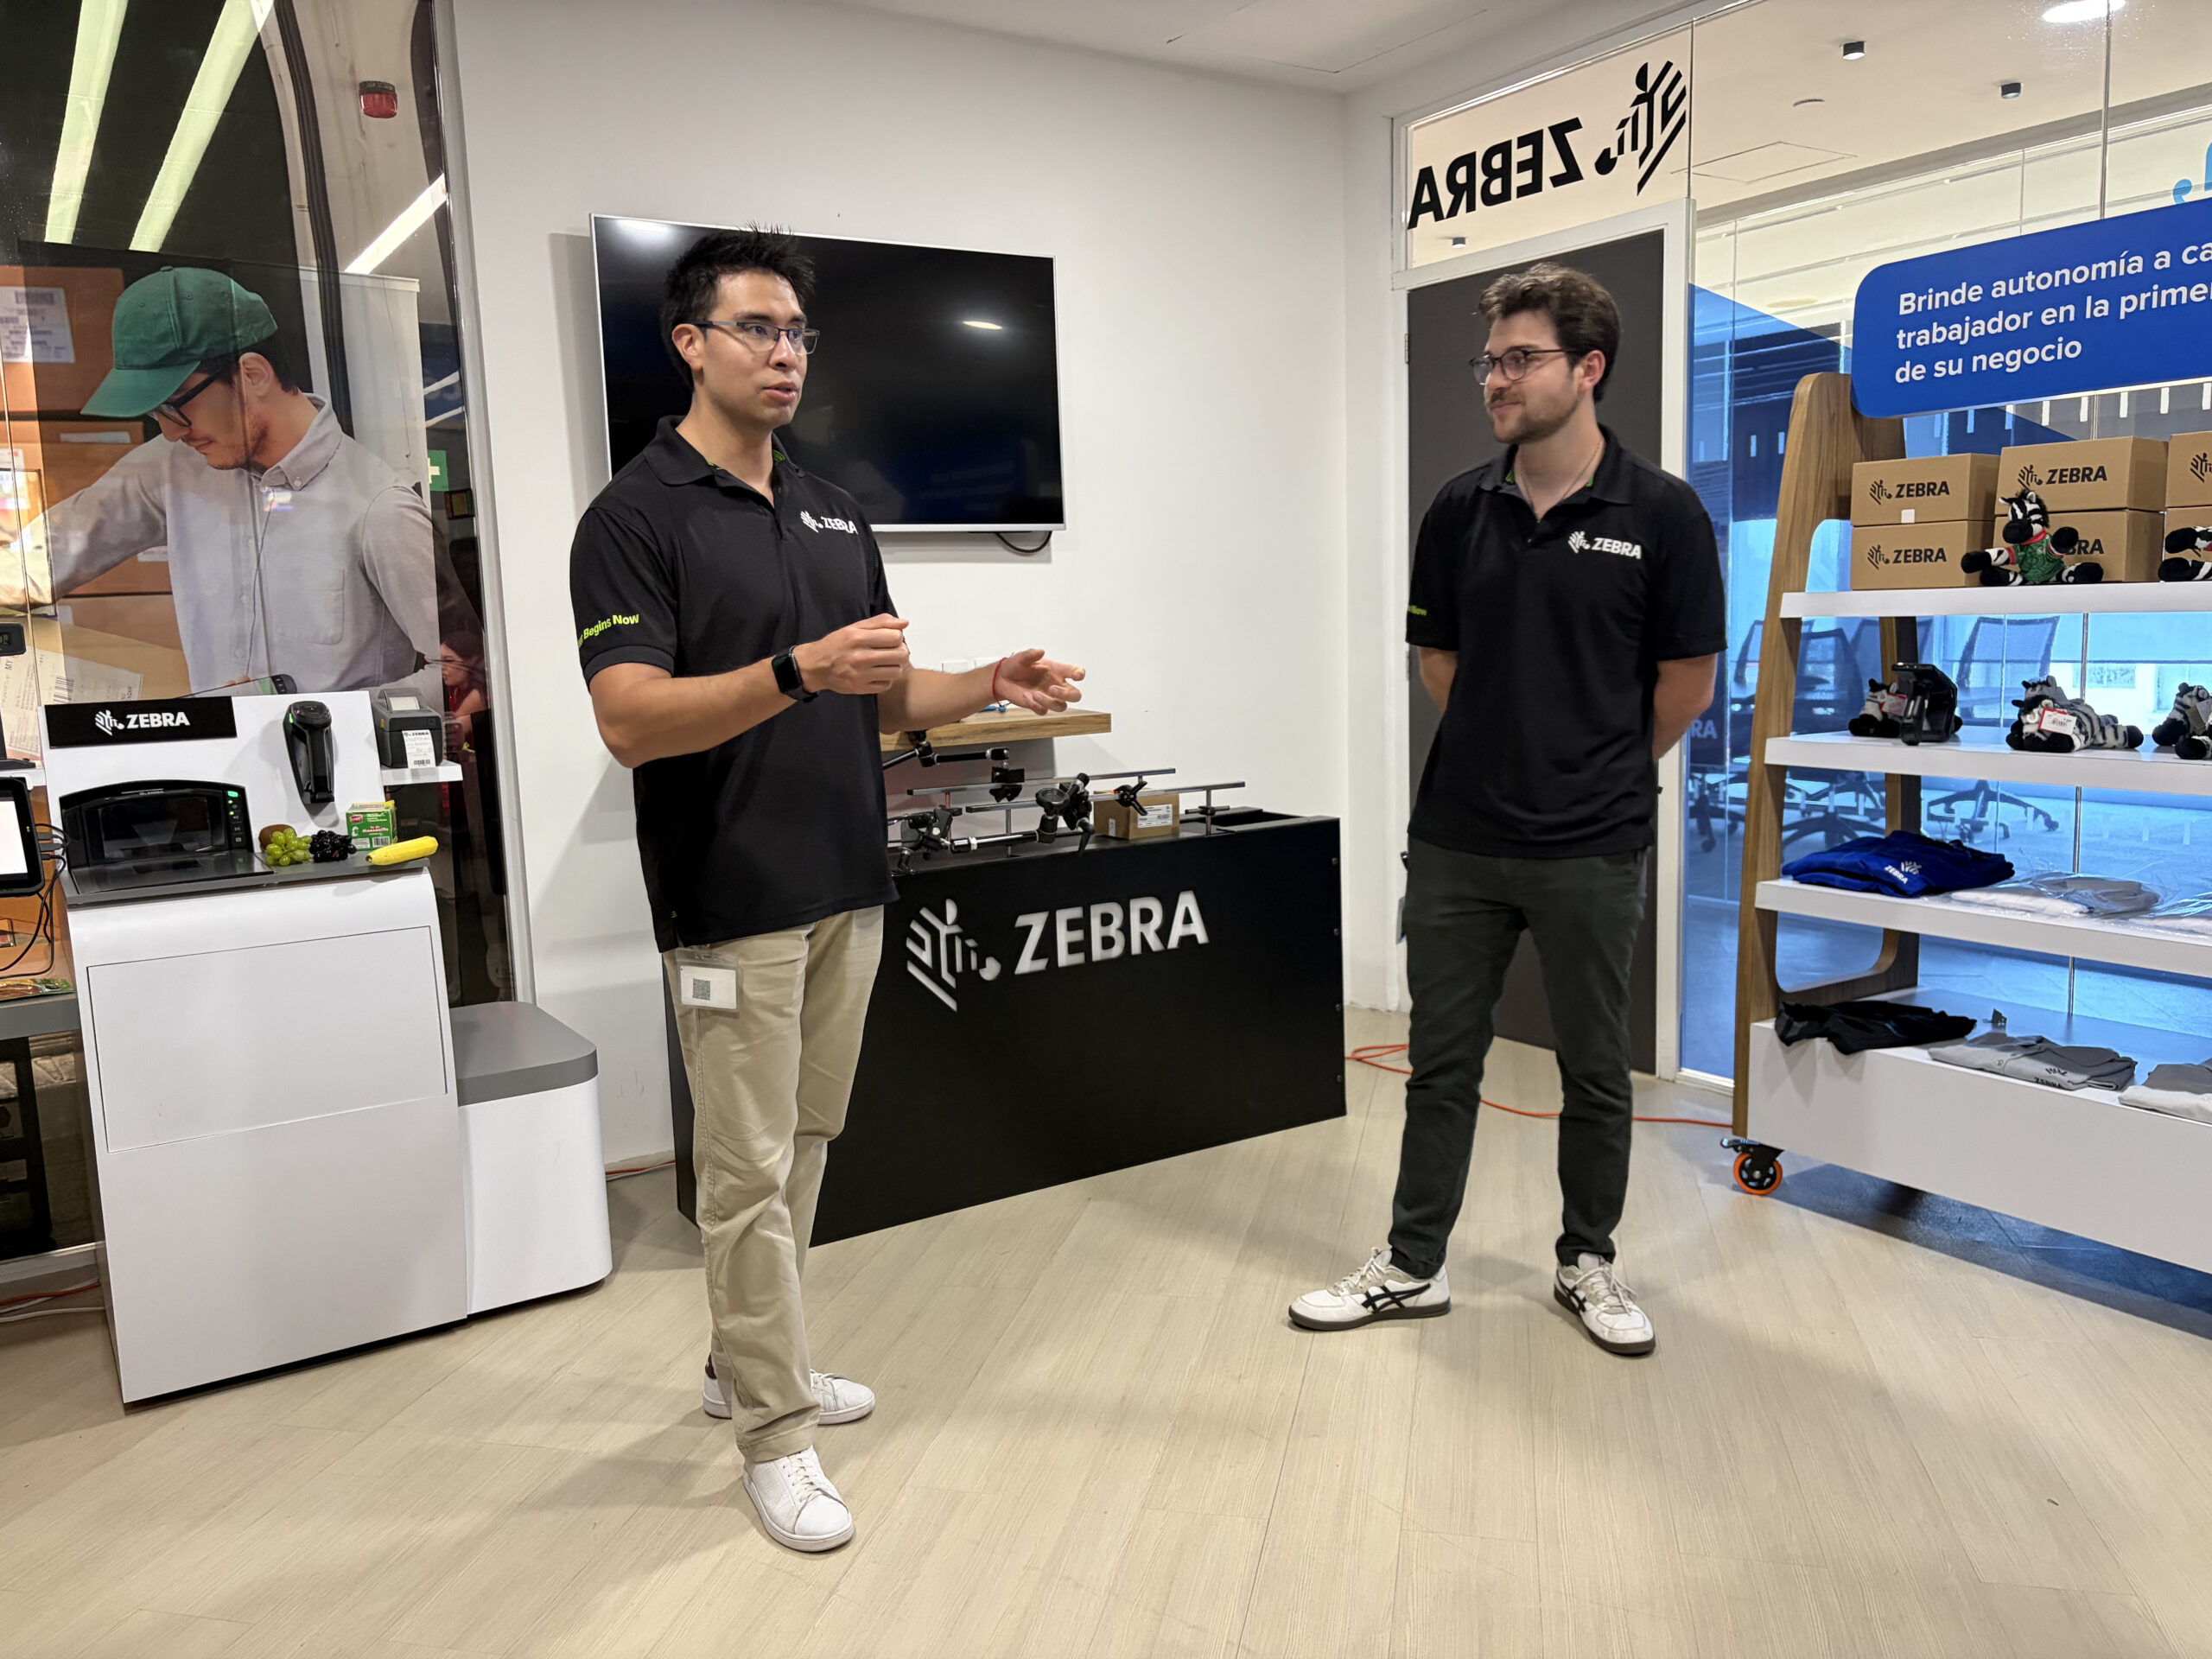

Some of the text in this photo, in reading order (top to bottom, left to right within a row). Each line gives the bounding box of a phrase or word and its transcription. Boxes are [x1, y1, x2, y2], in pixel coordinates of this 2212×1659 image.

[1899, 282, 1983, 315] Brinde
[1991, 250, 2144, 298] autonomía
[2153, 251, 2171, 270] a
[1896, 310, 2033, 350] trabajador
[2040, 303, 2075, 326] en
[2085, 296, 2109, 319] la
[1895, 336, 2082, 384] de su negocio
[2044, 465, 2107, 486] ZEBRA
[1895, 480, 1950, 499] ZEBRA
[820, 516, 859, 535] ZEBRA
[1591, 537, 1642, 560] ZEBRA
[1891, 547, 1947, 564] ZEBRA
[583, 613, 639, 640] Begins Now
[125, 711, 191, 729] ZEBRA
[1885, 864, 1909, 885] ZEBRA
[1014, 890, 1210, 975] ZEBRA
